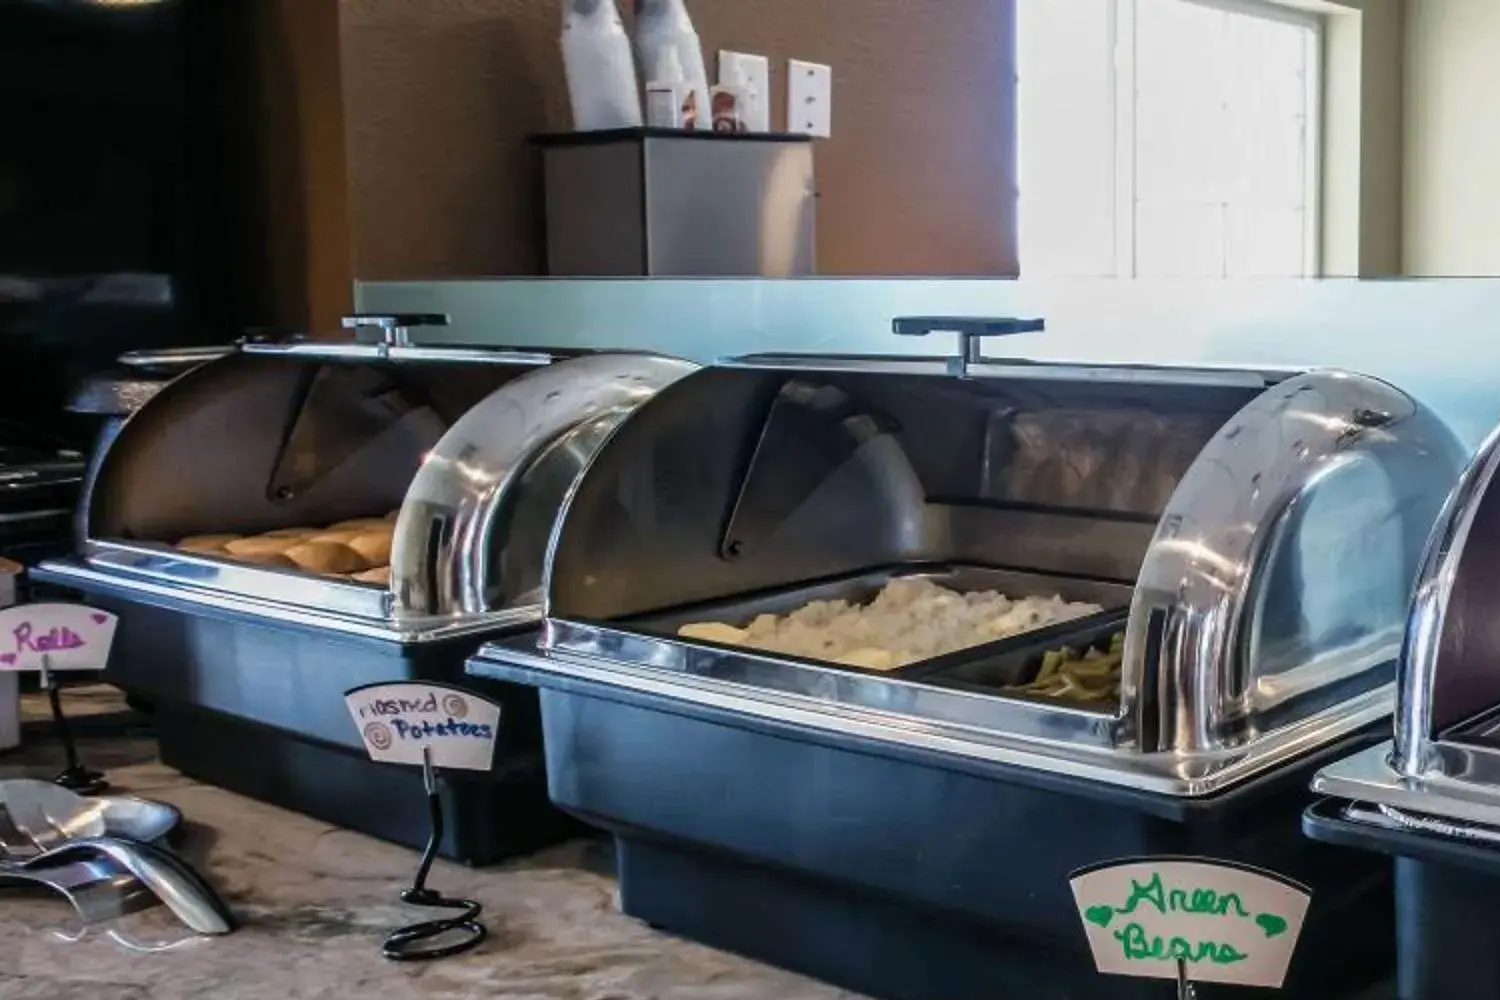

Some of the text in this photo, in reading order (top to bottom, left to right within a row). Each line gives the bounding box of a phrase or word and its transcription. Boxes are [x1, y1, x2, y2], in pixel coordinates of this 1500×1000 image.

[391, 717, 492, 740] Potatoes
[1115, 872, 1250, 915] Green
[1113, 922, 1248, 964] Beans
